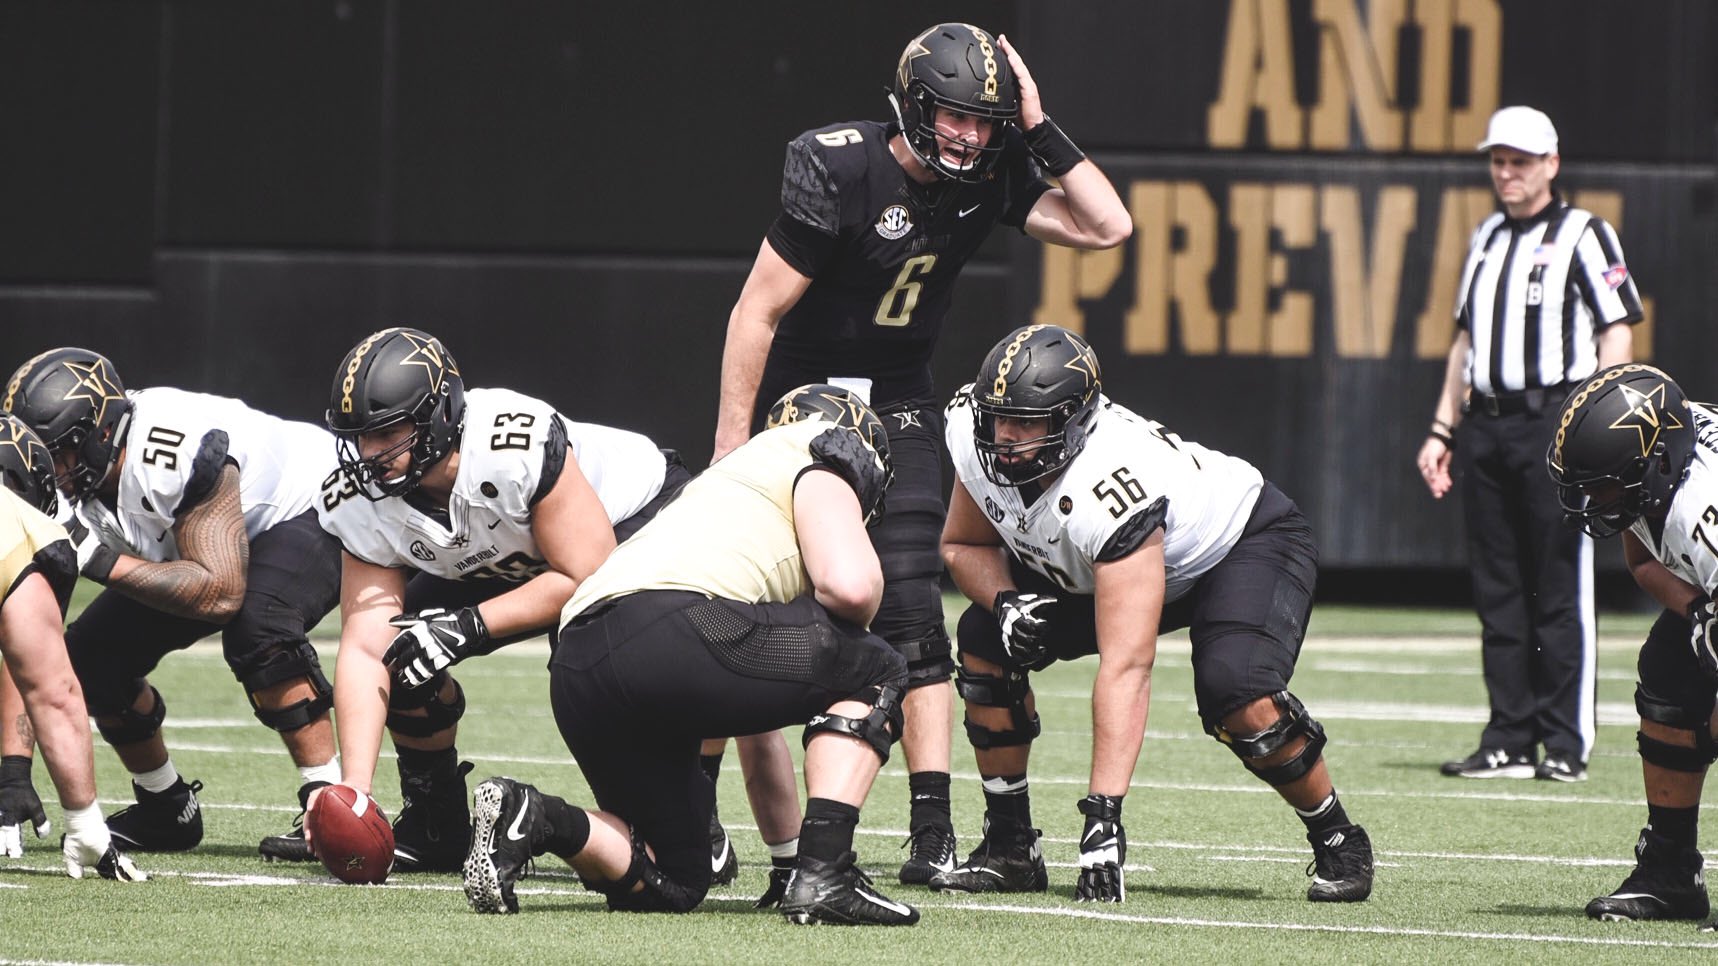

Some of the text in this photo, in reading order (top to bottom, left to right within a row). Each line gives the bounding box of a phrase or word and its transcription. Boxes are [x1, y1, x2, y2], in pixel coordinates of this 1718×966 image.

[1207, 0, 1503, 151] AND
[815, 129, 864, 147] 6
[883, 207, 907, 231] SEC
[873, 253, 939, 327] 6
[1032, 178, 1656, 357] PREVA
[142, 426, 186, 471] 50
[490, 412, 536, 452] 63
[1092, 466, 1149, 519] 56
[454, 544, 500, 572] VANDERBILT
